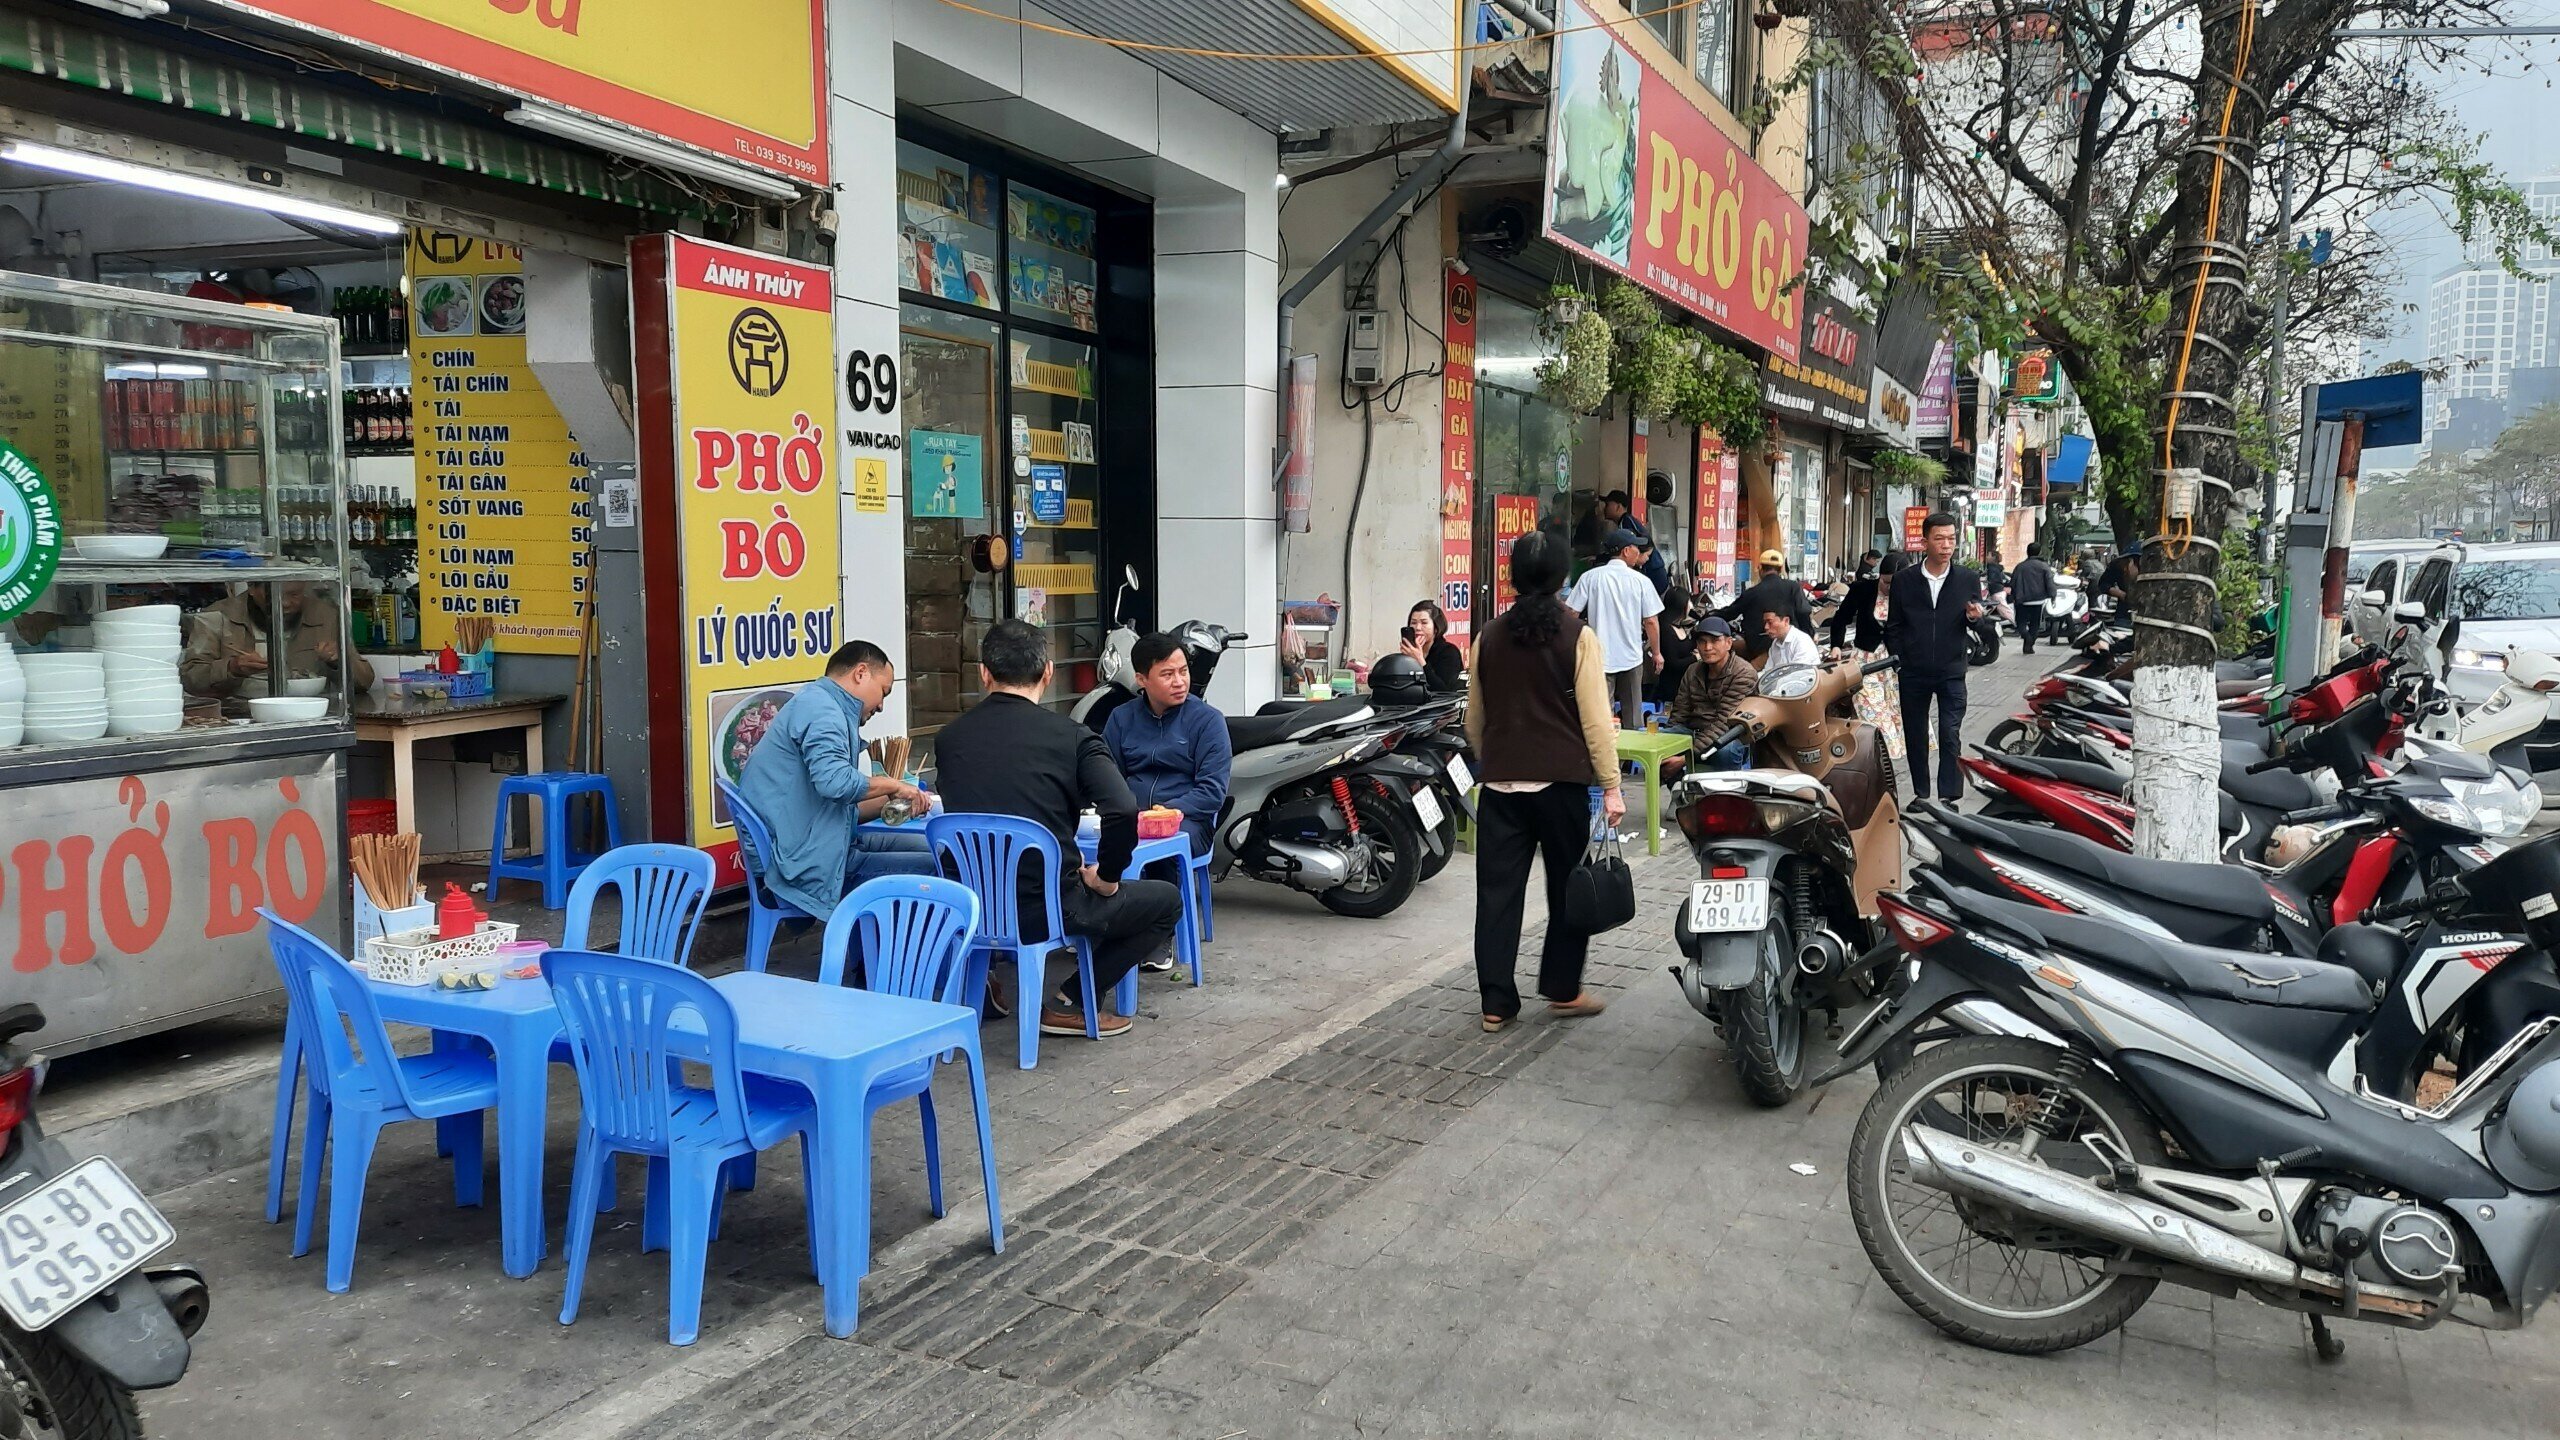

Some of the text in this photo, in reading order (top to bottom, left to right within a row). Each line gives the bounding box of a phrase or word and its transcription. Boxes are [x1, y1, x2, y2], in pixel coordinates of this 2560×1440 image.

[734, 137, 817, 175] TEL: 039 352 9999
[1645, 130, 1794, 330] PHỞ GÀ
[703, 257, 805, 299] ÁNH THỦY
[1457, 287, 1468, 305] 71
[433, 347, 475, 368] CHÍN
[1448, 342, 1475, 369] NHẬN
[433, 373, 508, 392] TÁI CHÍN
[846, 350, 897, 414] 69
[1448, 376, 1474, 405] ĐẶT
[434, 397, 460, 417] TÁI
[435, 421, 509, 445] TÁI NẠM
[1451, 412, 1469, 437] GÀ
[847, 430, 901, 450] VAN CAO
[436, 447, 462, 466] TÁI
[693, 413, 823, 494] PHỞ
[437, 472, 464, 491] TÁI
[470, 473, 506, 491] GÂN
[1704, 470, 1717, 486] GÀ
[0, 450, 60, 547] THỰC PHẨM
[439, 494, 471, 515] SỐT
[477, 500, 523, 516] VANG
[1499, 498, 1537, 534] PHỞ GÀ
[1702, 515, 1715, 529] GÀ
[439, 521, 466, 540] LÕI
[1445, 517, 1471, 541] NGUYÊN
[721, 504, 805, 579] BÒ
[440, 545, 466, 564] LÕI
[473, 549, 514, 568] NẠM
[1445, 554, 1470, 575] CON
[441, 570, 467, 588] LÕI
[442, 596, 520, 617] ĐẶC BIỆT
[1445, 582, 1469, 610] 156
[499, 624, 528, 636] khách
[530, 627, 554, 638] ngon
[698, 596, 834, 667] LÝ QUỐC SƯ
[0, 775, 327, 974] HỞ BÒ
[1701, 882, 1755, 905] 29-D1
[1694, 905, 1762, 928] 489.44
[2440, 931, 2504, 944] HONDA
[0, 1174, 113, 1270] 29-B1
[11, 1207, 159, 1315] 495.80
